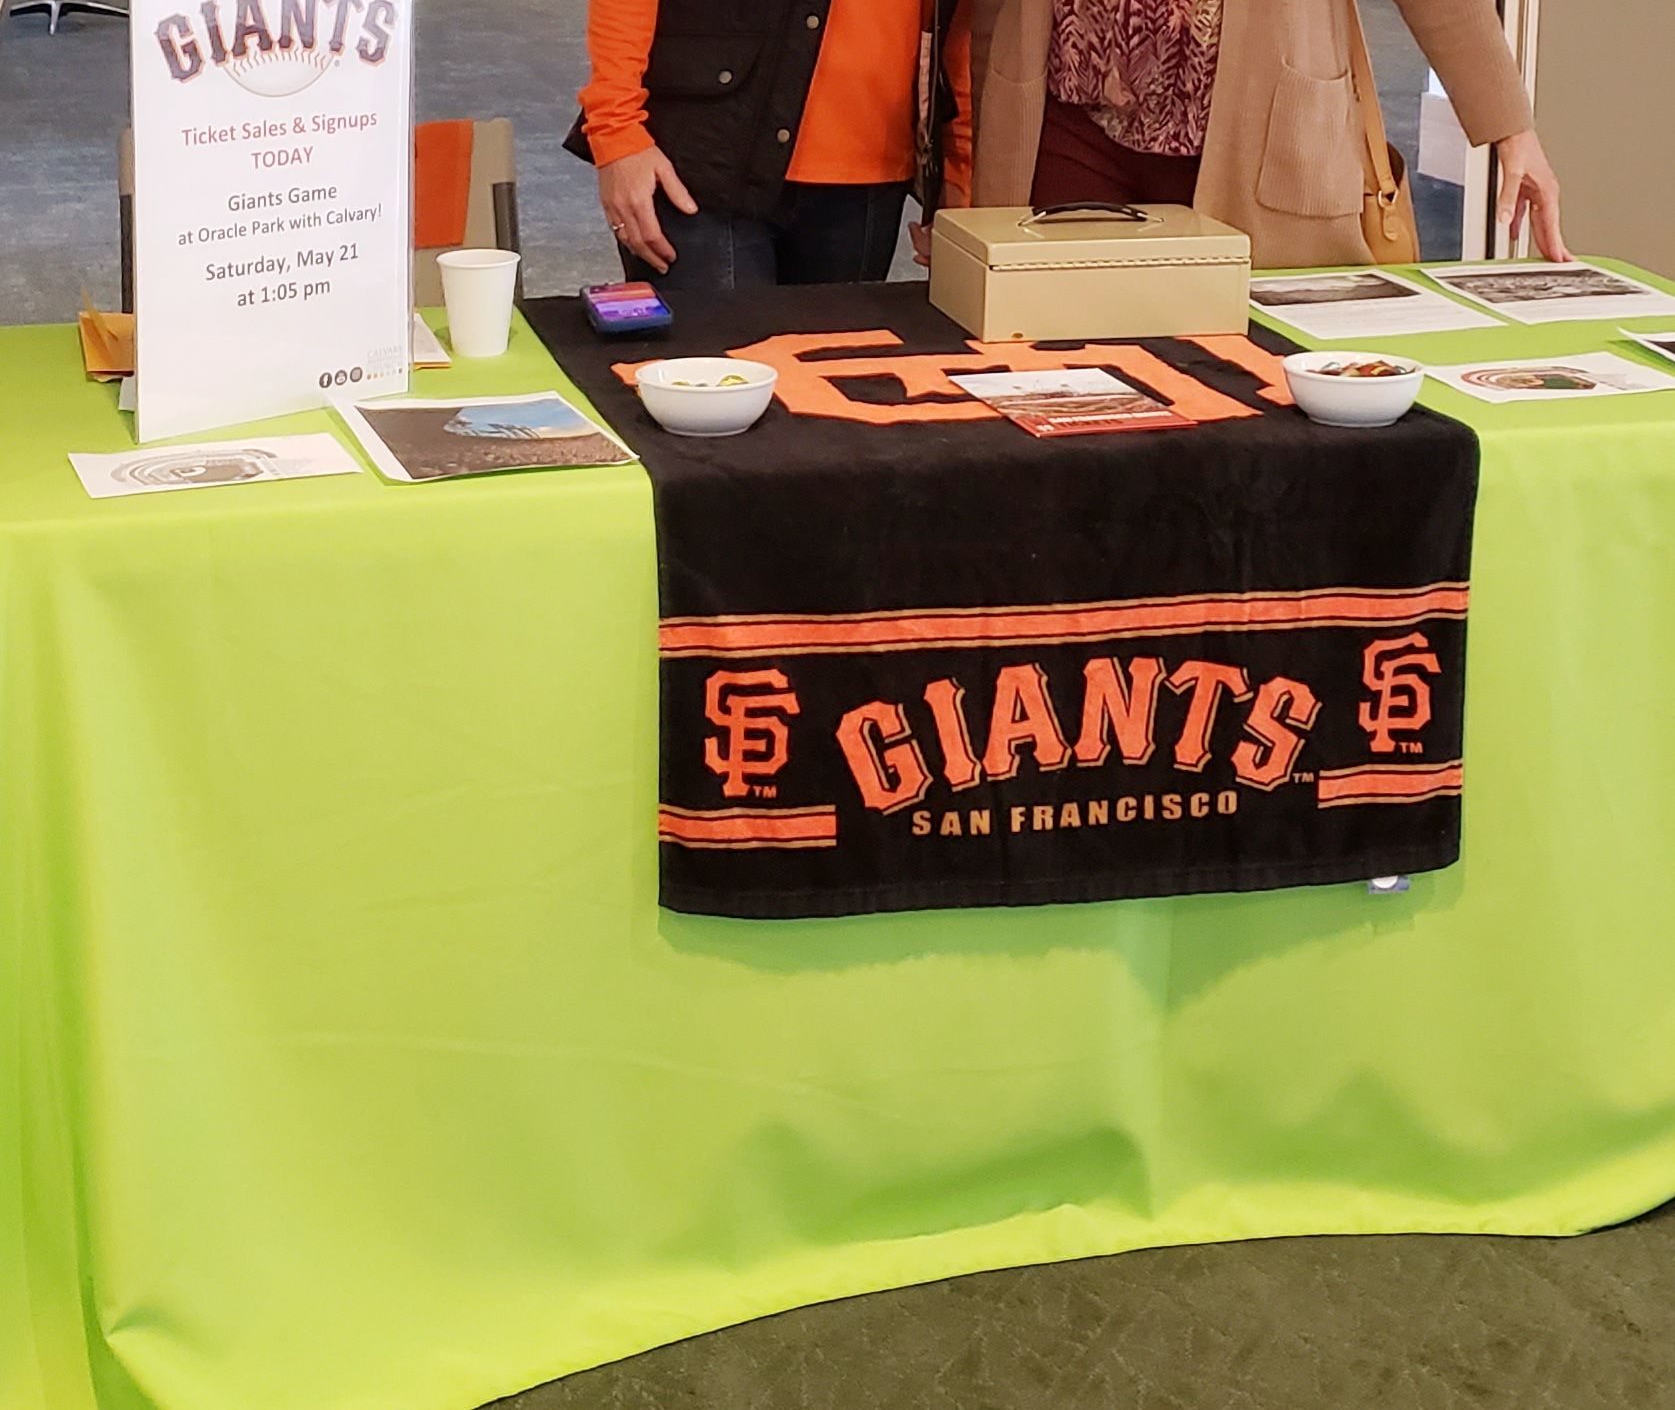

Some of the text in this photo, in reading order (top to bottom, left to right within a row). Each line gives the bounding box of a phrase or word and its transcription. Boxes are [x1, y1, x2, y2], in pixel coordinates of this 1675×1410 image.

[182, 112, 378, 146] Ticket Sales & Signups
[251, 146, 314, 170] TODAY
[228, 184, 337, 211] Giants Game
[178, 203, 382, 245] at Oracle Park with Calvary!
[206, 243, 359, 281] Saturday, May 21
[237, 280, 331, 306] at 1:05 pm
[834, 656, 1323, 816] GIANTS
[911, 790, 1239, 837] SAN FRANCISCO
